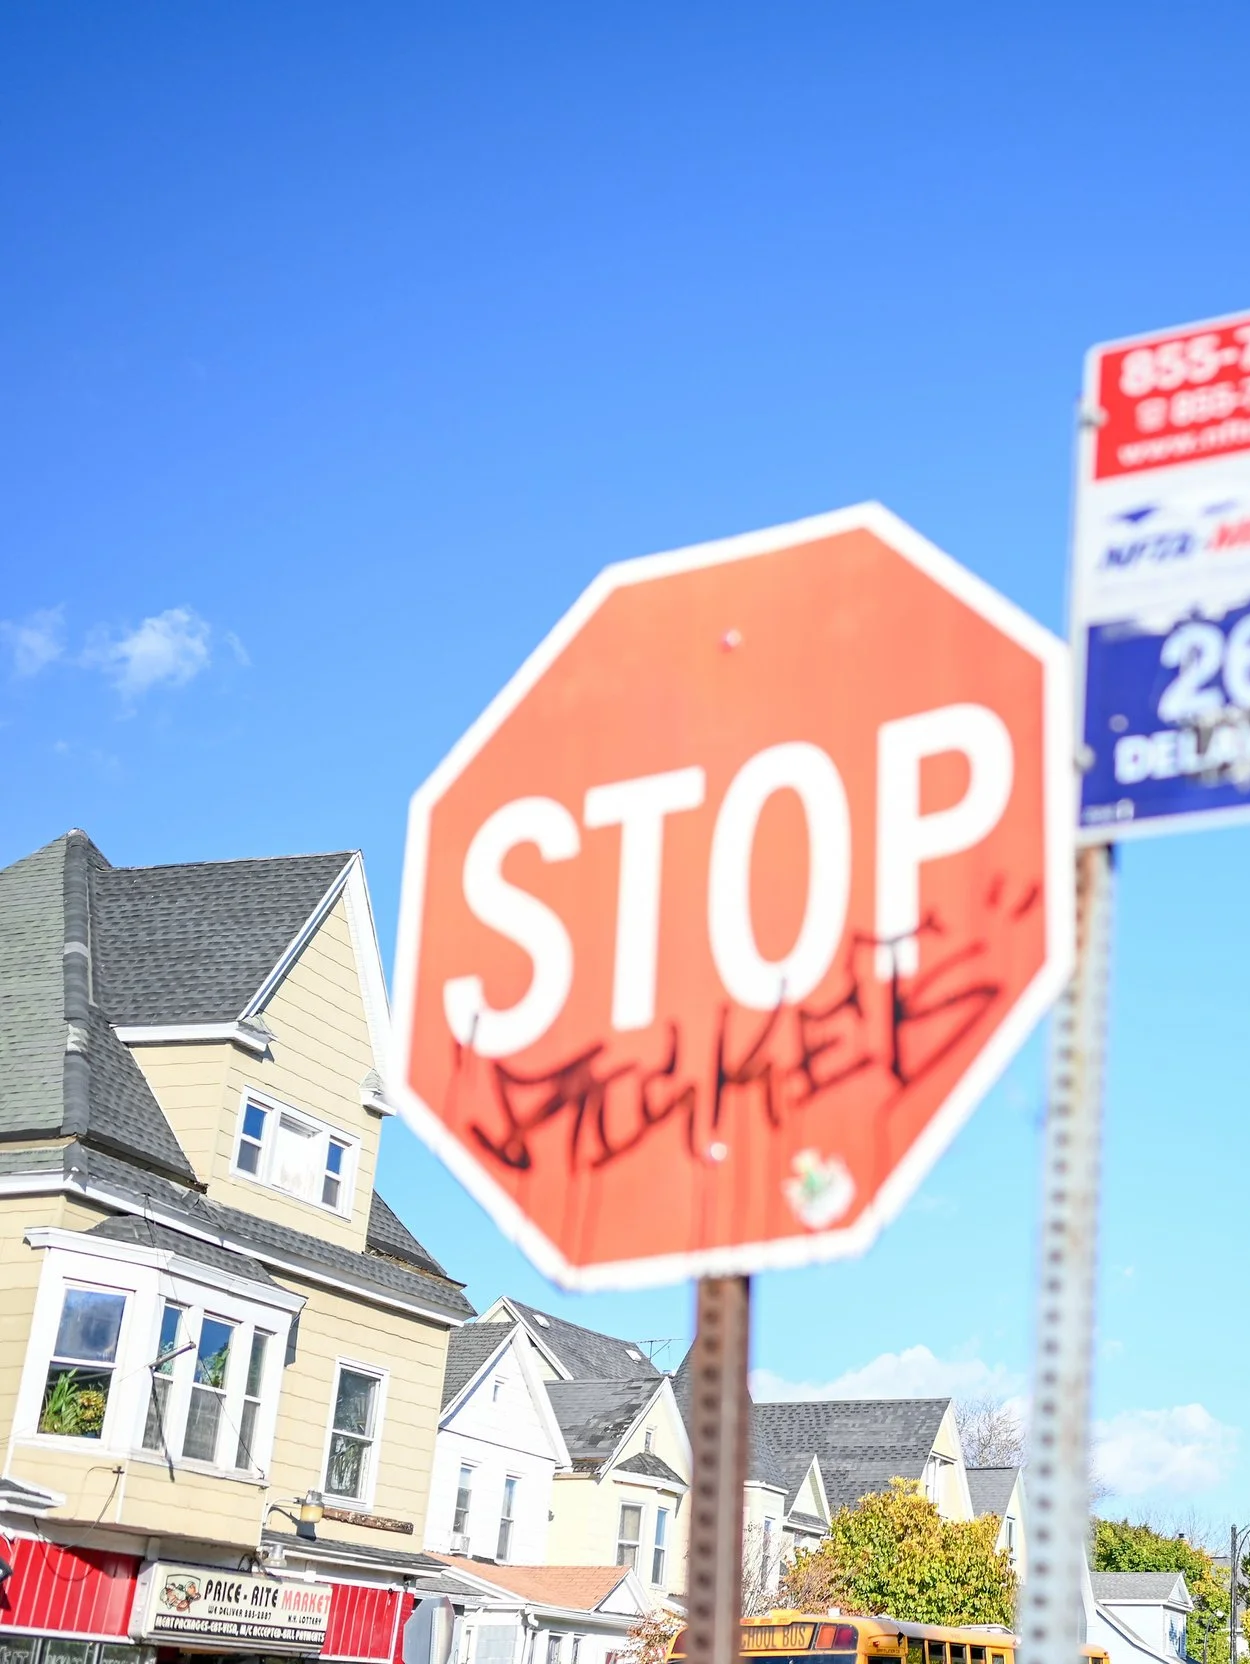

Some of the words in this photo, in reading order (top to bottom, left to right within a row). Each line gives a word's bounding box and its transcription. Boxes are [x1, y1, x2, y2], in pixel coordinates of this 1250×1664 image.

[443, 703, 1014, 1057] STOP
[208, 1605, 218, 1614] WE
[219, 1607, 243, 1618] DELIVER
[281, 1590, 331, 1614] MARKET
[155, 1615, 175, 1628] MEAT
[295, 1629, 326, 1643] PAYMENTS
[298, 1616, 322, 1626] LOTTERY
[739, 1625, 776, 1649] CHOOL
[782, 1624, 806, 1648] BUS
